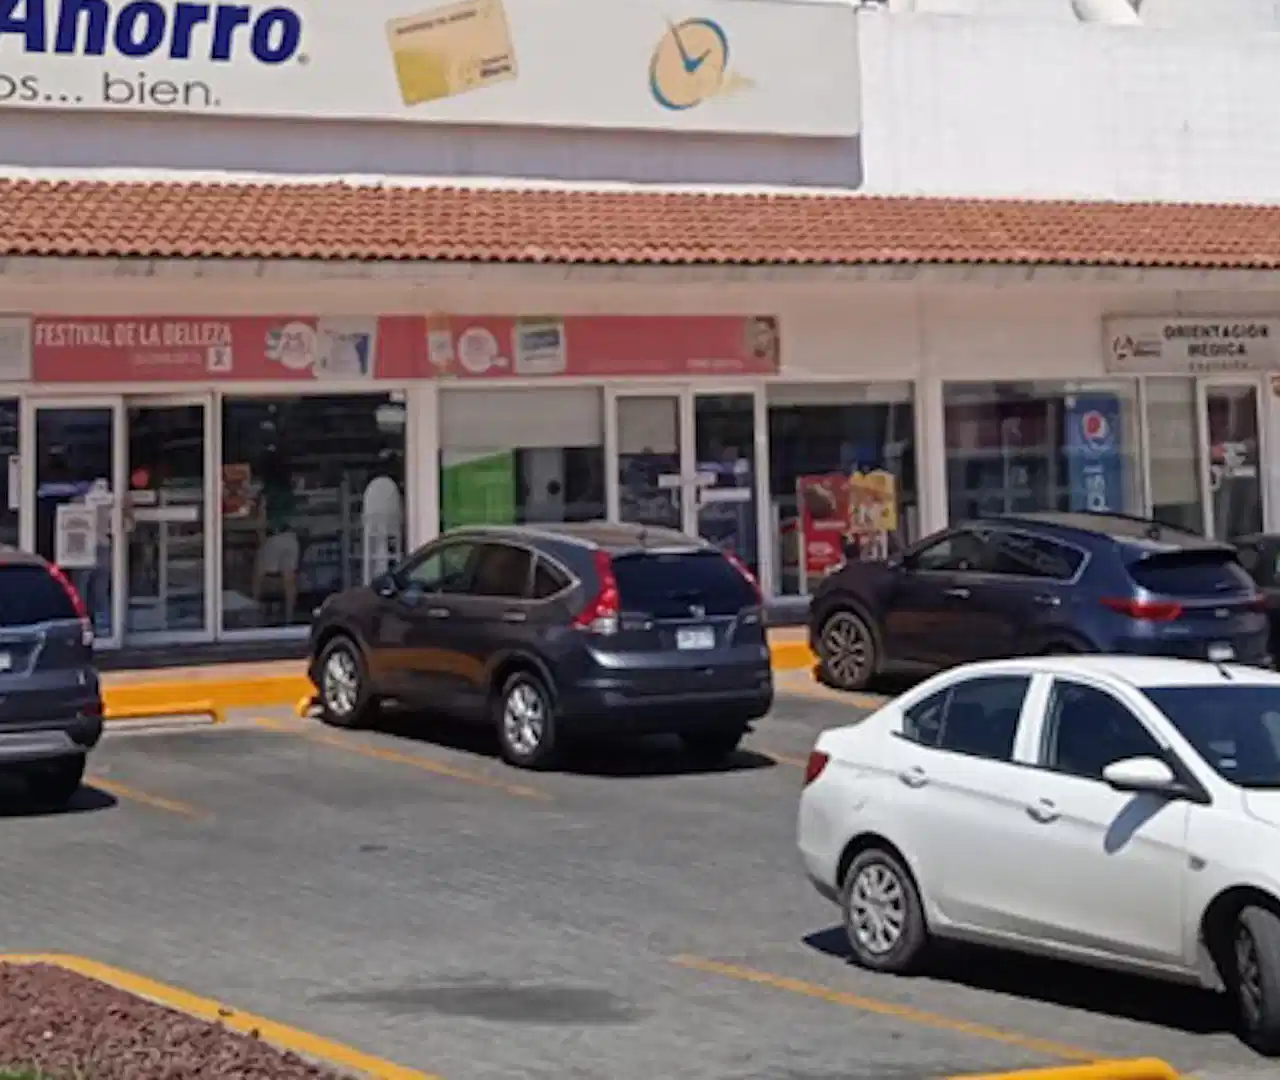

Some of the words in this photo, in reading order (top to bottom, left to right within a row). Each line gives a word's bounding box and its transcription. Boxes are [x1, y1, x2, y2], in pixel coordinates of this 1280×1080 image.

[102, 71, 222, 108] bien.
[35, 322, 111, 347] FESTIVAL
[114, 322, 138, 347] DE
[140, 322, 160, 346] LA
[163, 322, 233, 345] BELLEZA
